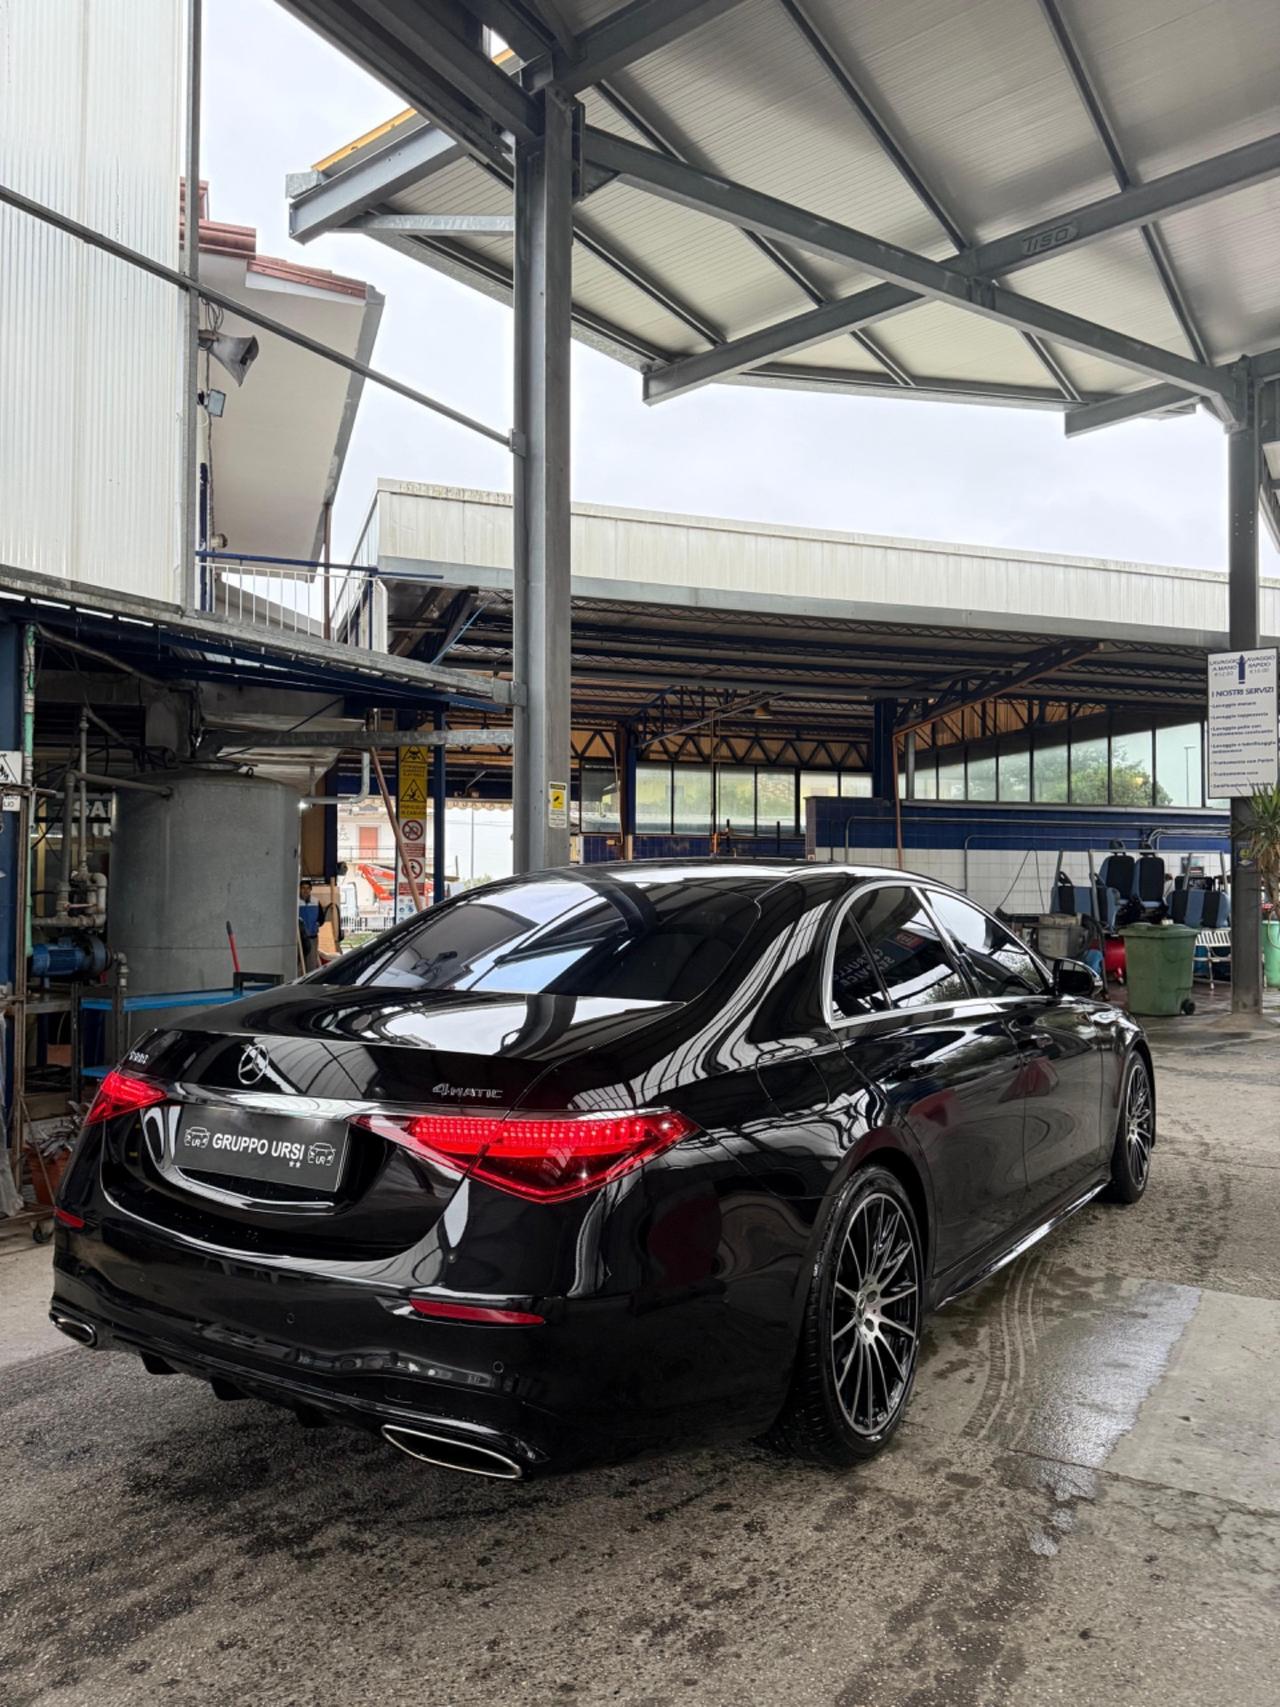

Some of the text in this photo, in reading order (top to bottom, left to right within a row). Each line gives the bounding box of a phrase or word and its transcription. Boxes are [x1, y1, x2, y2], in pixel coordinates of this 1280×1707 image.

[1245, 654, 1275, 662] AVAGGIO
[1216, 689, 1244, 697] NOSTRI
[1245, 686, 1274, 695] SERVIZI
[73, 801, 113, 818] SA
[432, 1082, 503, 1098] 4MATIC
[212, 1133, 306, 1160] GRUPPO URSI
